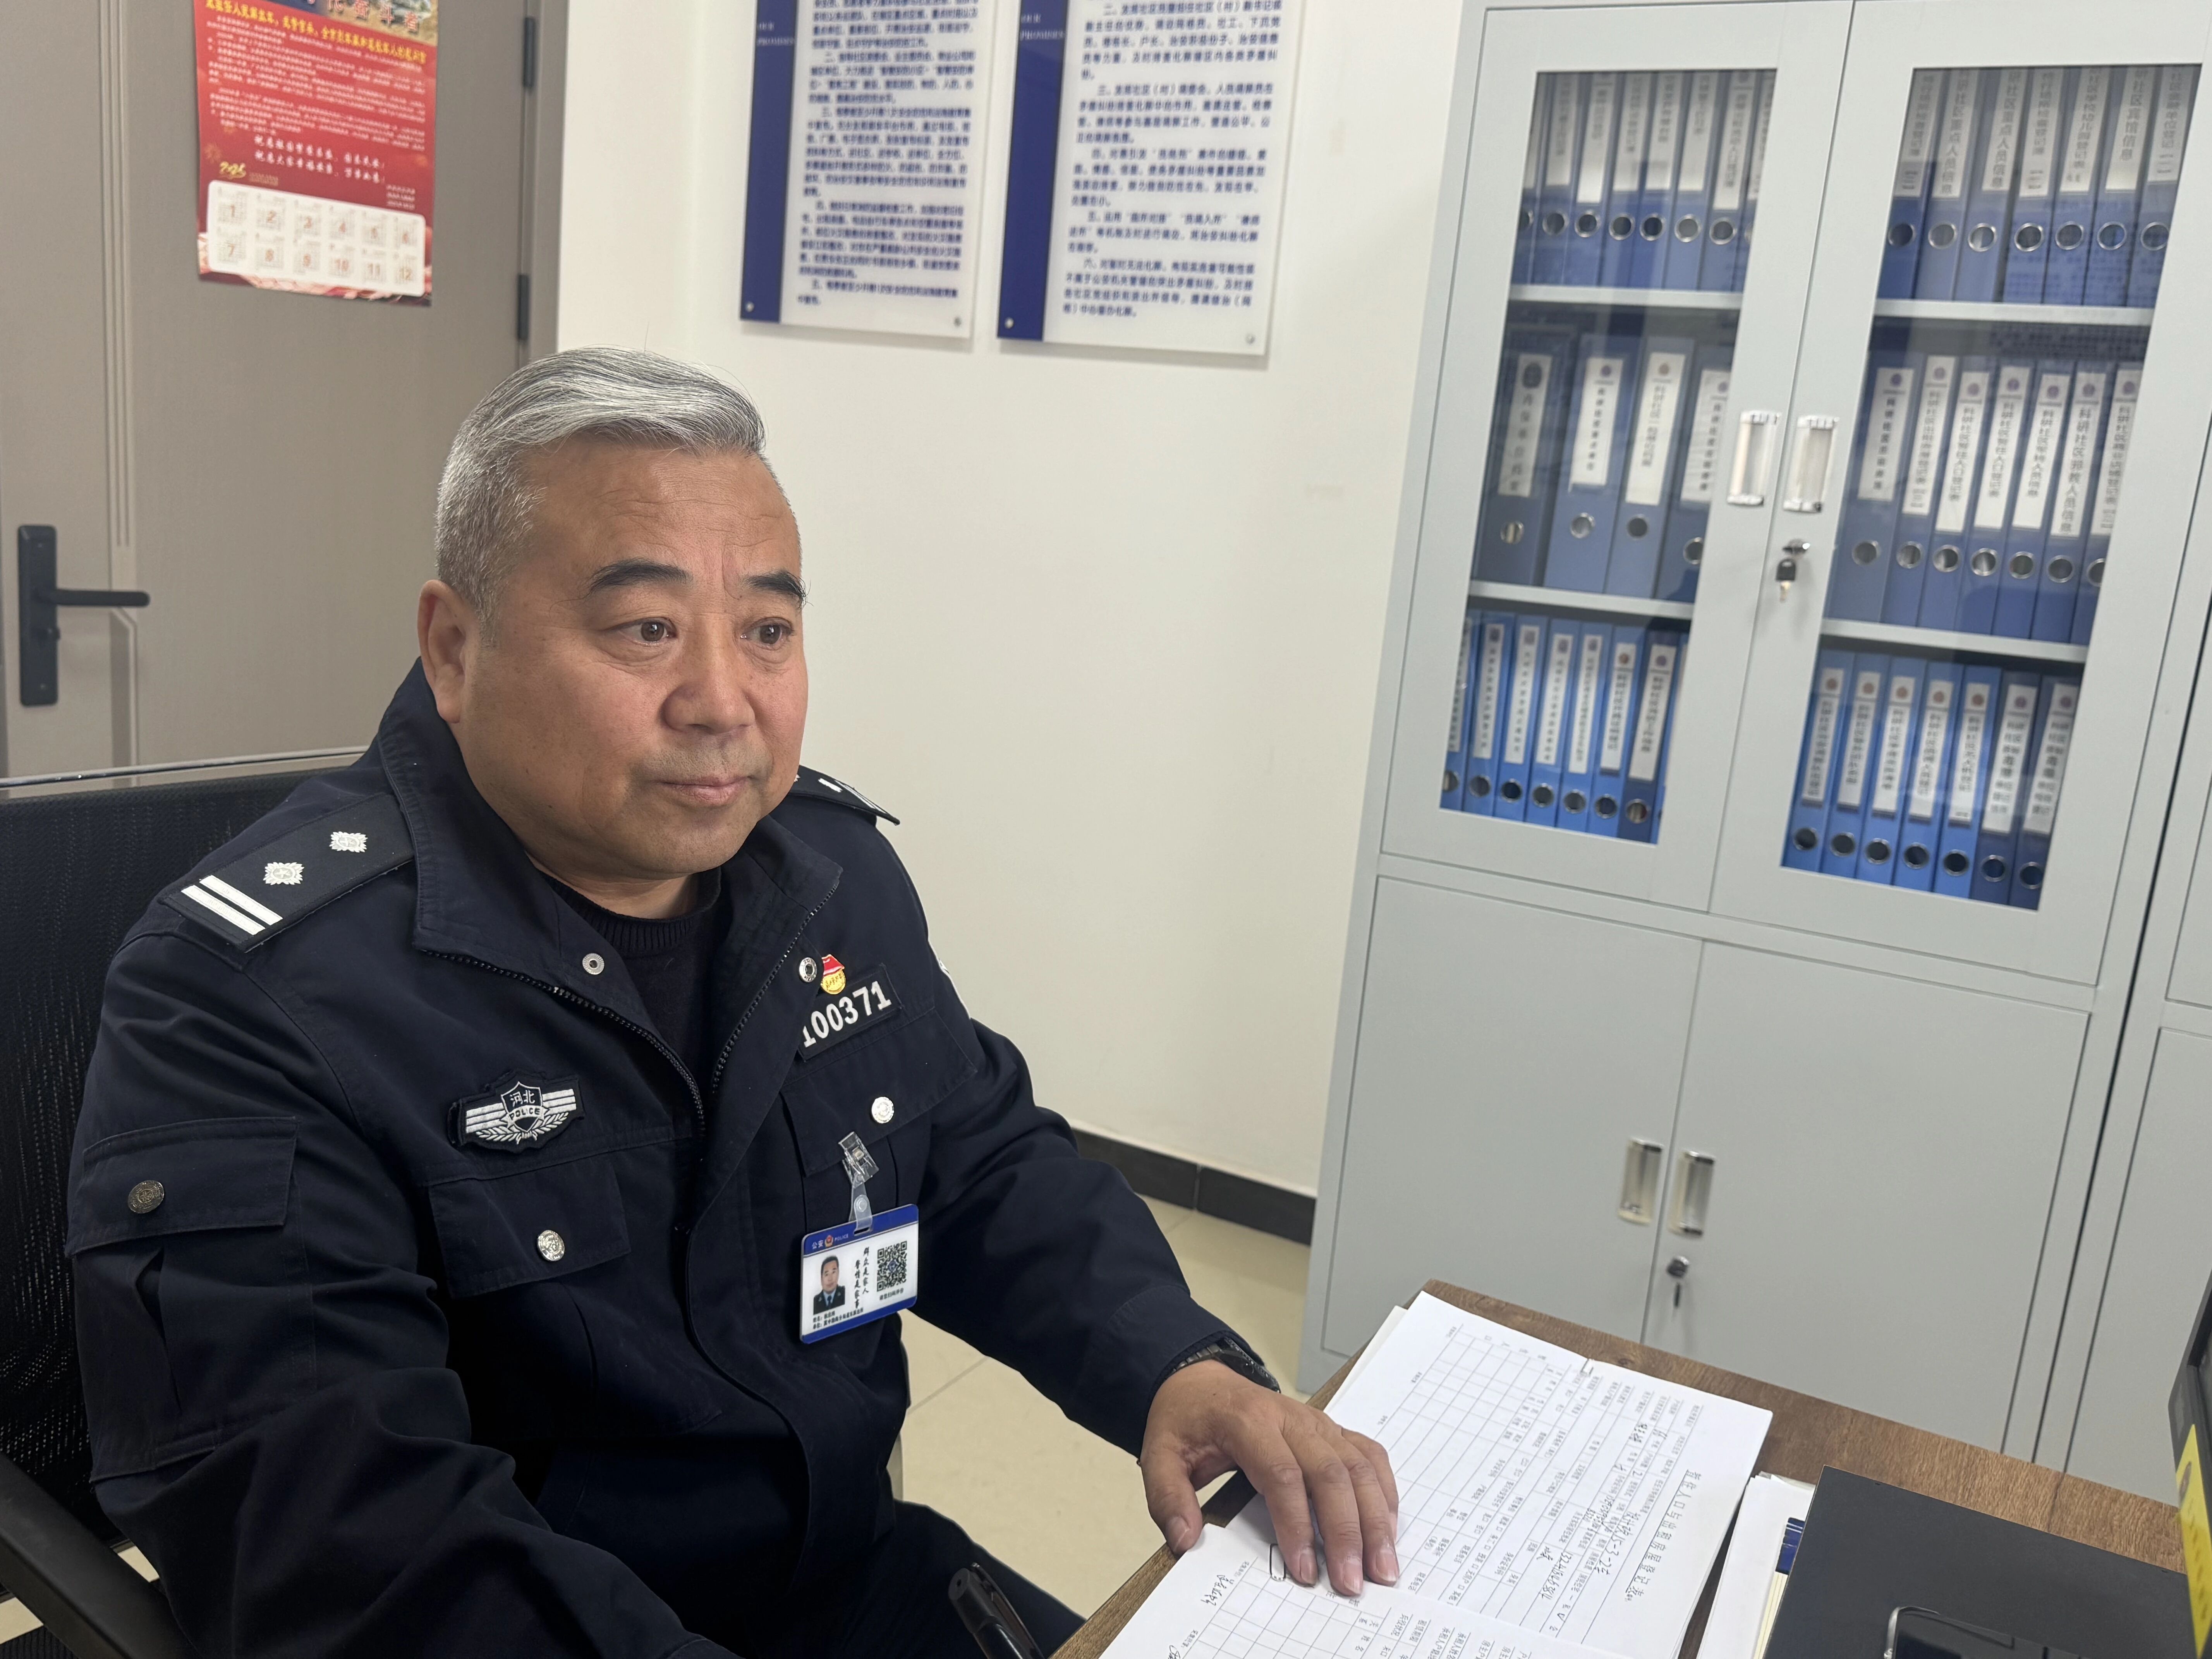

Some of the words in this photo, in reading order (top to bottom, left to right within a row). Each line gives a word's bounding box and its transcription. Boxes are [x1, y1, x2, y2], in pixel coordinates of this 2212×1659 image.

[803, 981, 892, 1048] 100371
[510, 1089, 535, 1107] 河北
[510, 1108, 541, 1120] POLICE
[812, 1240, 824, 1249] 公安
[835, 1233, 848, 1242] POLICE
[1629, 1472, 1700, 1595] 暂住人口与出租房屋登记表
[1494, 1552, 1514, 1578] 身份证号码
[1408, 1572, 1426, 1594] 联系电话
[1391, 1614, 1408, 1637] 兵役状况
[1409, 1620, 1427, 1642] 租赁期限
[1446, 1633, 1466, 1659] 承租人姓名
[1499, 1646, 1511, 1659] 房主
